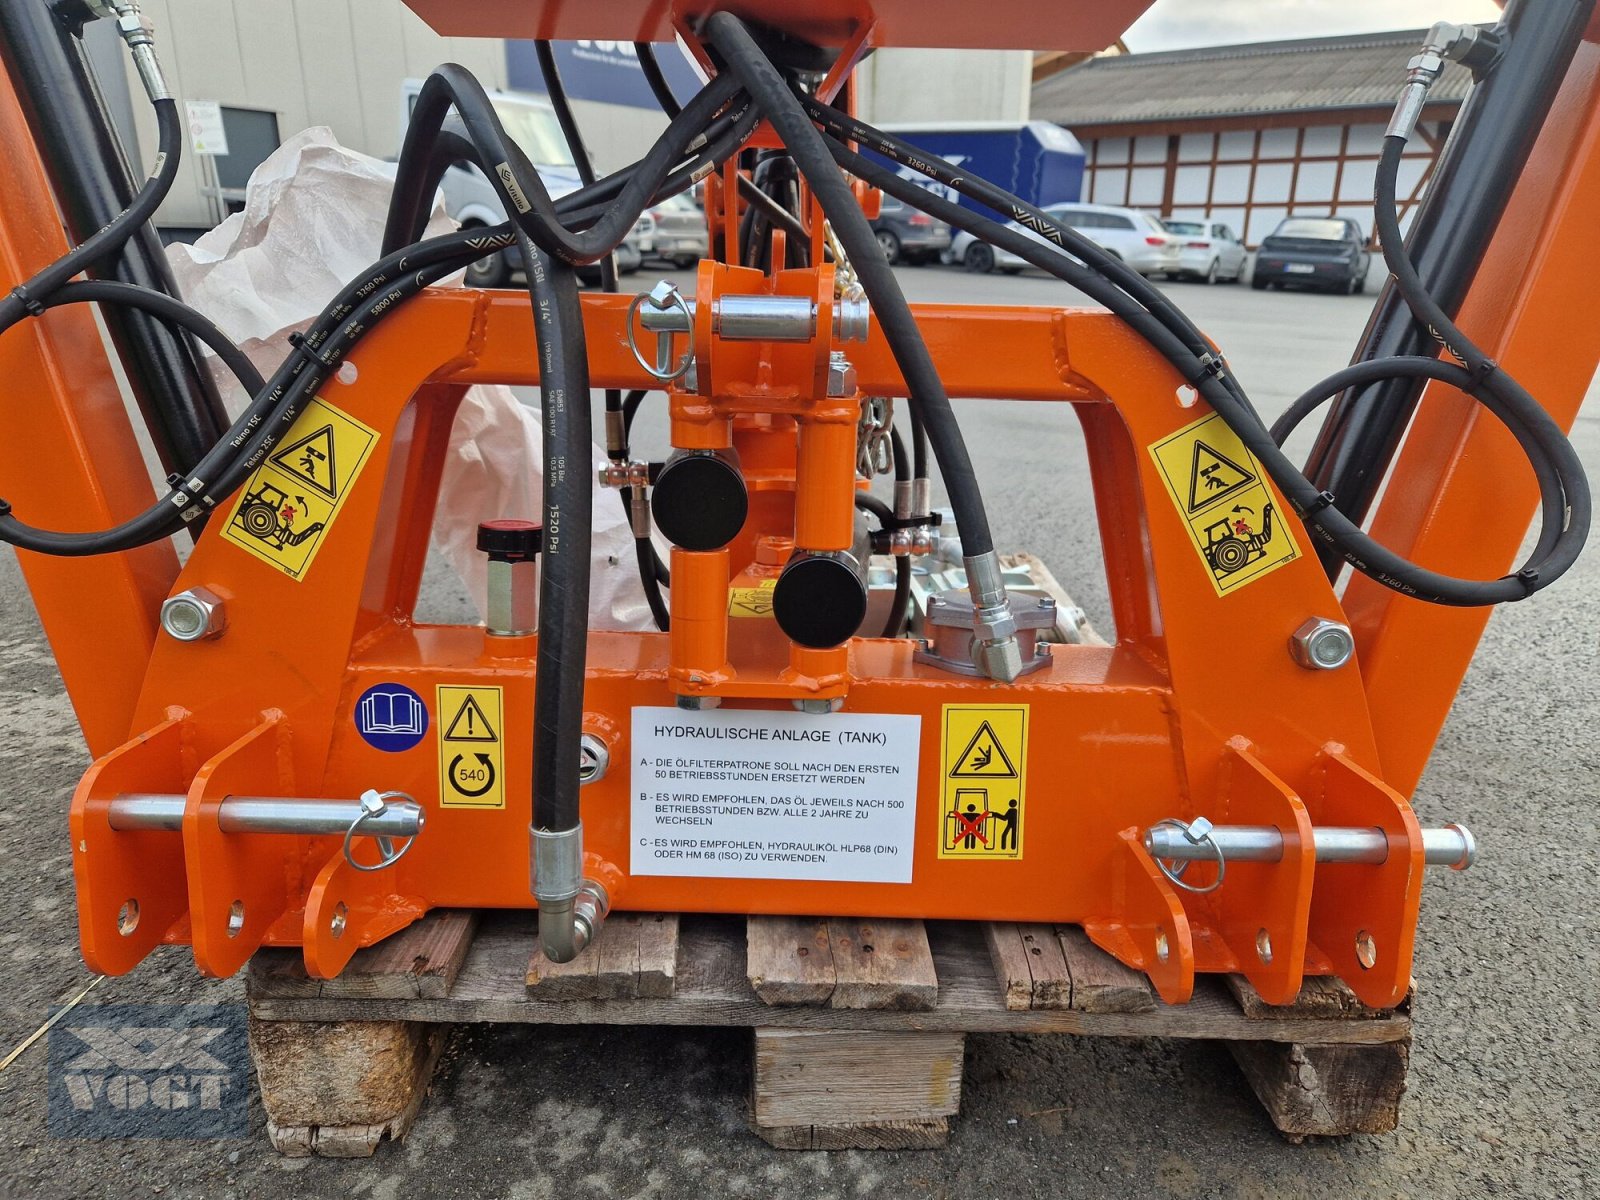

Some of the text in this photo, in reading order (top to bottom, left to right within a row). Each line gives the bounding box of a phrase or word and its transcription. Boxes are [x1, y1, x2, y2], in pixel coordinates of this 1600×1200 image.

[908, 156, 937, 177] 3260 Psi
[508, 184, 525, 211] Vitillo
[533, 261, 546, 283] 1SN
[356, 273, 388, 298] 3260 Psi
[370, 288, 402, 316] 5800 Psi
[540, 299, 552, 325] 3/4"
[269, 385, 283, 402] 1/4"
[556, 389, 564, 413] EN853
[282, 405, 295, 422] 1/4"
[229, 414, 262, 448] Tekno 1SC
[243, 434, 276, 469] Tekno 2SC
[550, 504, 560, 555] 1520 Psi
[1378, 572, 1417, 595] 3260 Psi
[654, 725, 887, 746] HYDRAULISCHE ANLAGE (TANK)
[460, 769, 485, 781] 540
[640, 758, 648, 766] A
[655, 758, 673, 768] DIE
[675, 757, 771, 770] ÖLFILTERPATRONE
[774, 762, 800, 771] SOLL
[802, 763, 832, 772] NACH
[834, 764, 855, 773] DEN
[858, 765, 900, 774] ERSTEN
[655, 770, 866, 785] 50 BETRIEBSSTUNDEN ERSETZT WERDEN
[640, 792, 647, 801] B
[656, 793, 670, 802] ES
[672, 793, 700, 803] WIRD
[702, 794, 768, 806] EMPFOHLEN,
[770, 796, 792, 805] DAS
[794, 795, 808, 806] ÖL
[809, 797, 854, 807] JEWEILS
[856, 799, 885, 808] NACH
[887, 800, 905, 809] 500
[655, 804, 869, 819] BETRIEBSSTUNDEN BZW. ALLE 2 JAHRE ZU
[655, 816, 713, 826] WECHSELN
[639, 838, 648, 847] C
[670, 839, 698, 848] WIRD
[700, 840, 765, 851] EMPFOHLEN,
[768, 842, 838, 852] HYDRAULIKÖL
[841, 844, 872, 853] HLP68
[873, 845, 898, 856] (DIN)
[654, 850, 828, 863] ODER HM 68 (ISO) ZU VERWENDEN.
